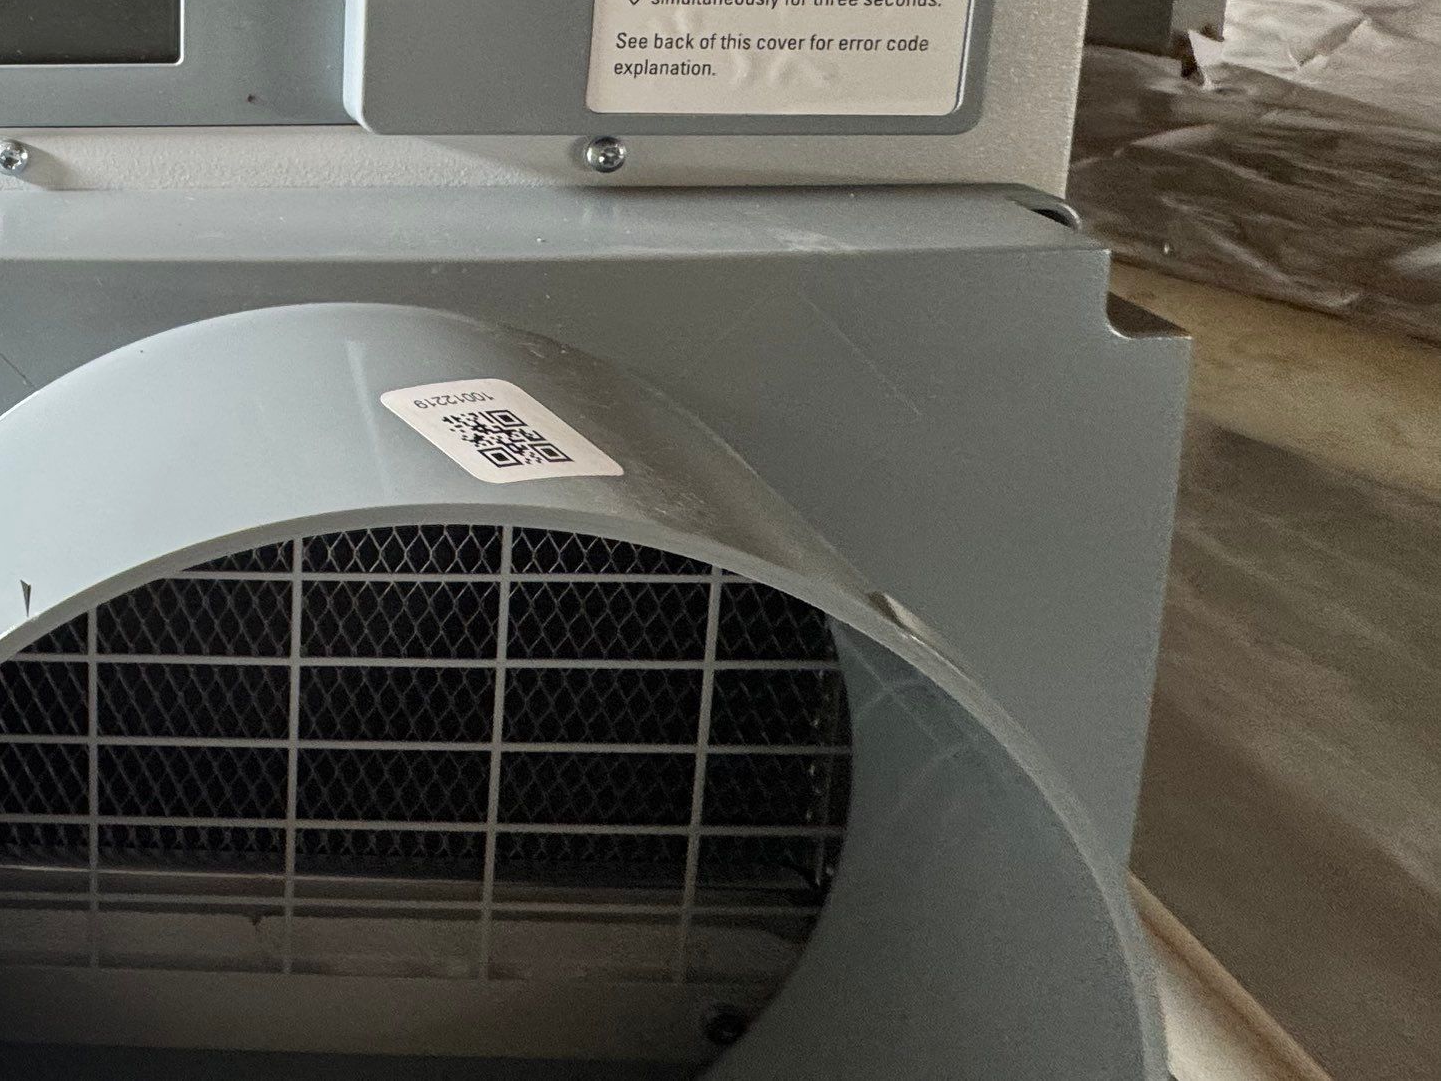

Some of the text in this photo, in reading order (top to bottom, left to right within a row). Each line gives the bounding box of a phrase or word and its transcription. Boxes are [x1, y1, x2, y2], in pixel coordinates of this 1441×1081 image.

[616, 32, 929, 51] See back of this cover for error code
[614, 59, 717, 78] explanation.
[413, 391, 495, 409] 10012219
